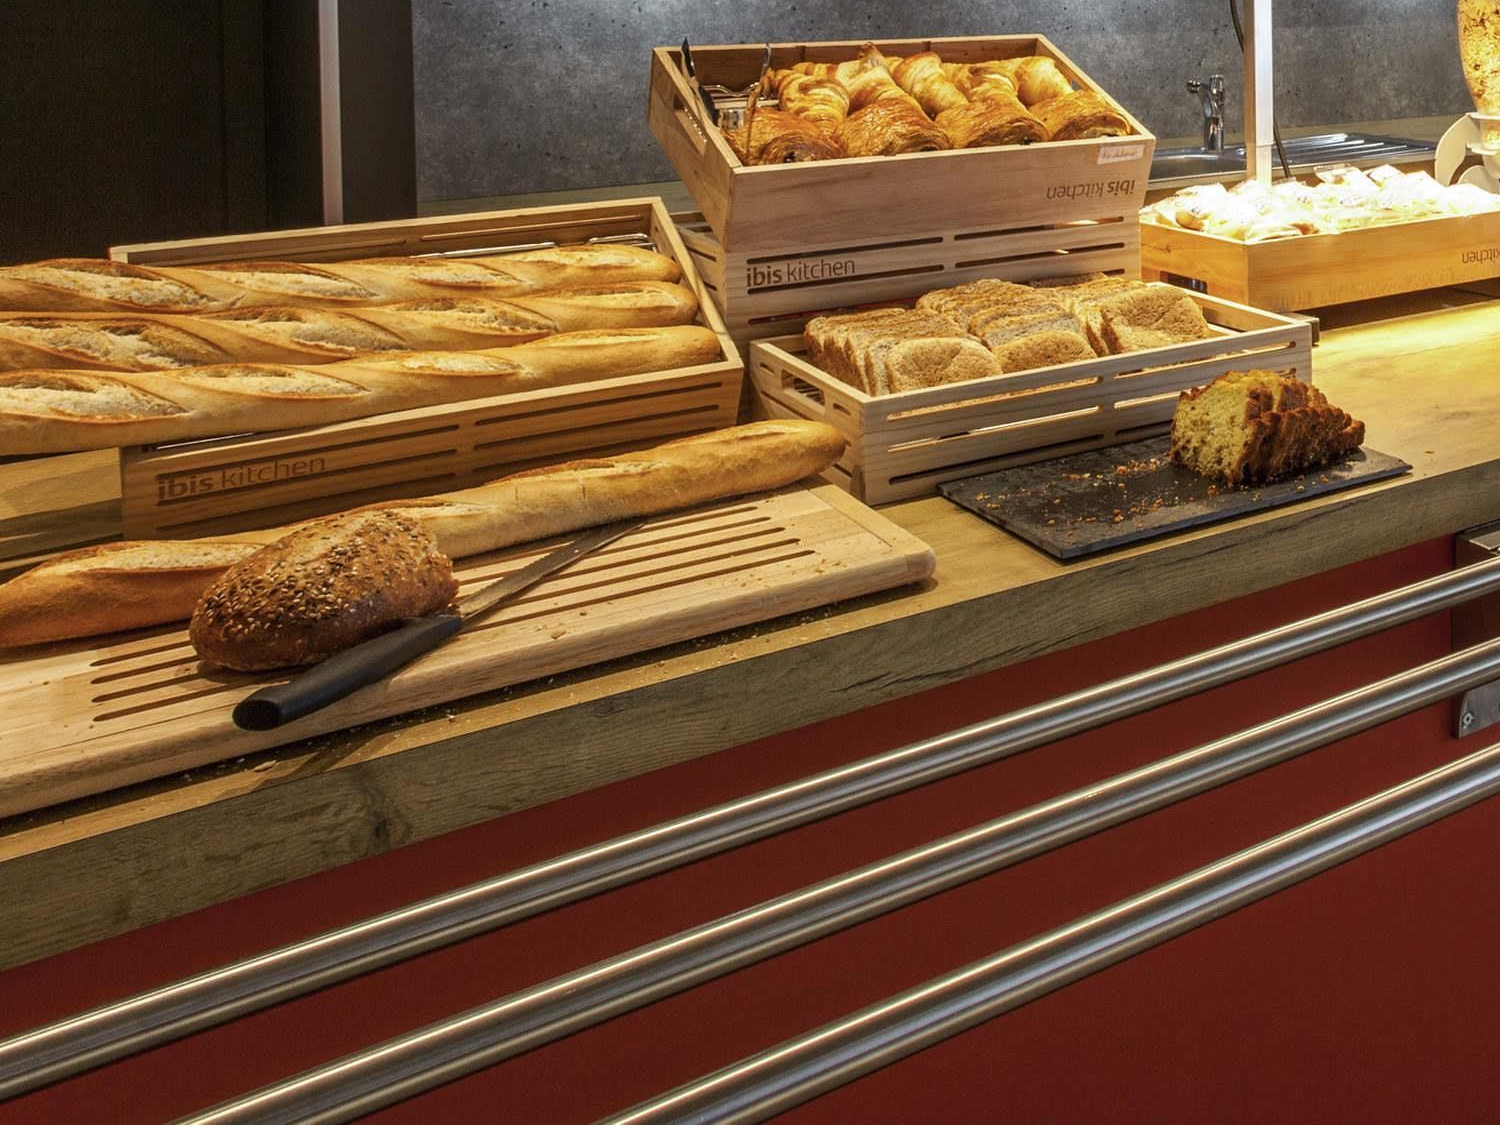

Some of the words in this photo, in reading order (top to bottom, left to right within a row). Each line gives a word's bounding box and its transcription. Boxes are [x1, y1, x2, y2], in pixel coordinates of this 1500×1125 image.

[1046, 182, 1105, 200] kitchen
[1107, 180, 1135, 195] ibis
[746, 265, 782, 287] ibis
[787, 259, 856, 282] kitchen
[157, 474, 214, 500] ibis
[221, 456, 326, 489] kitchen
